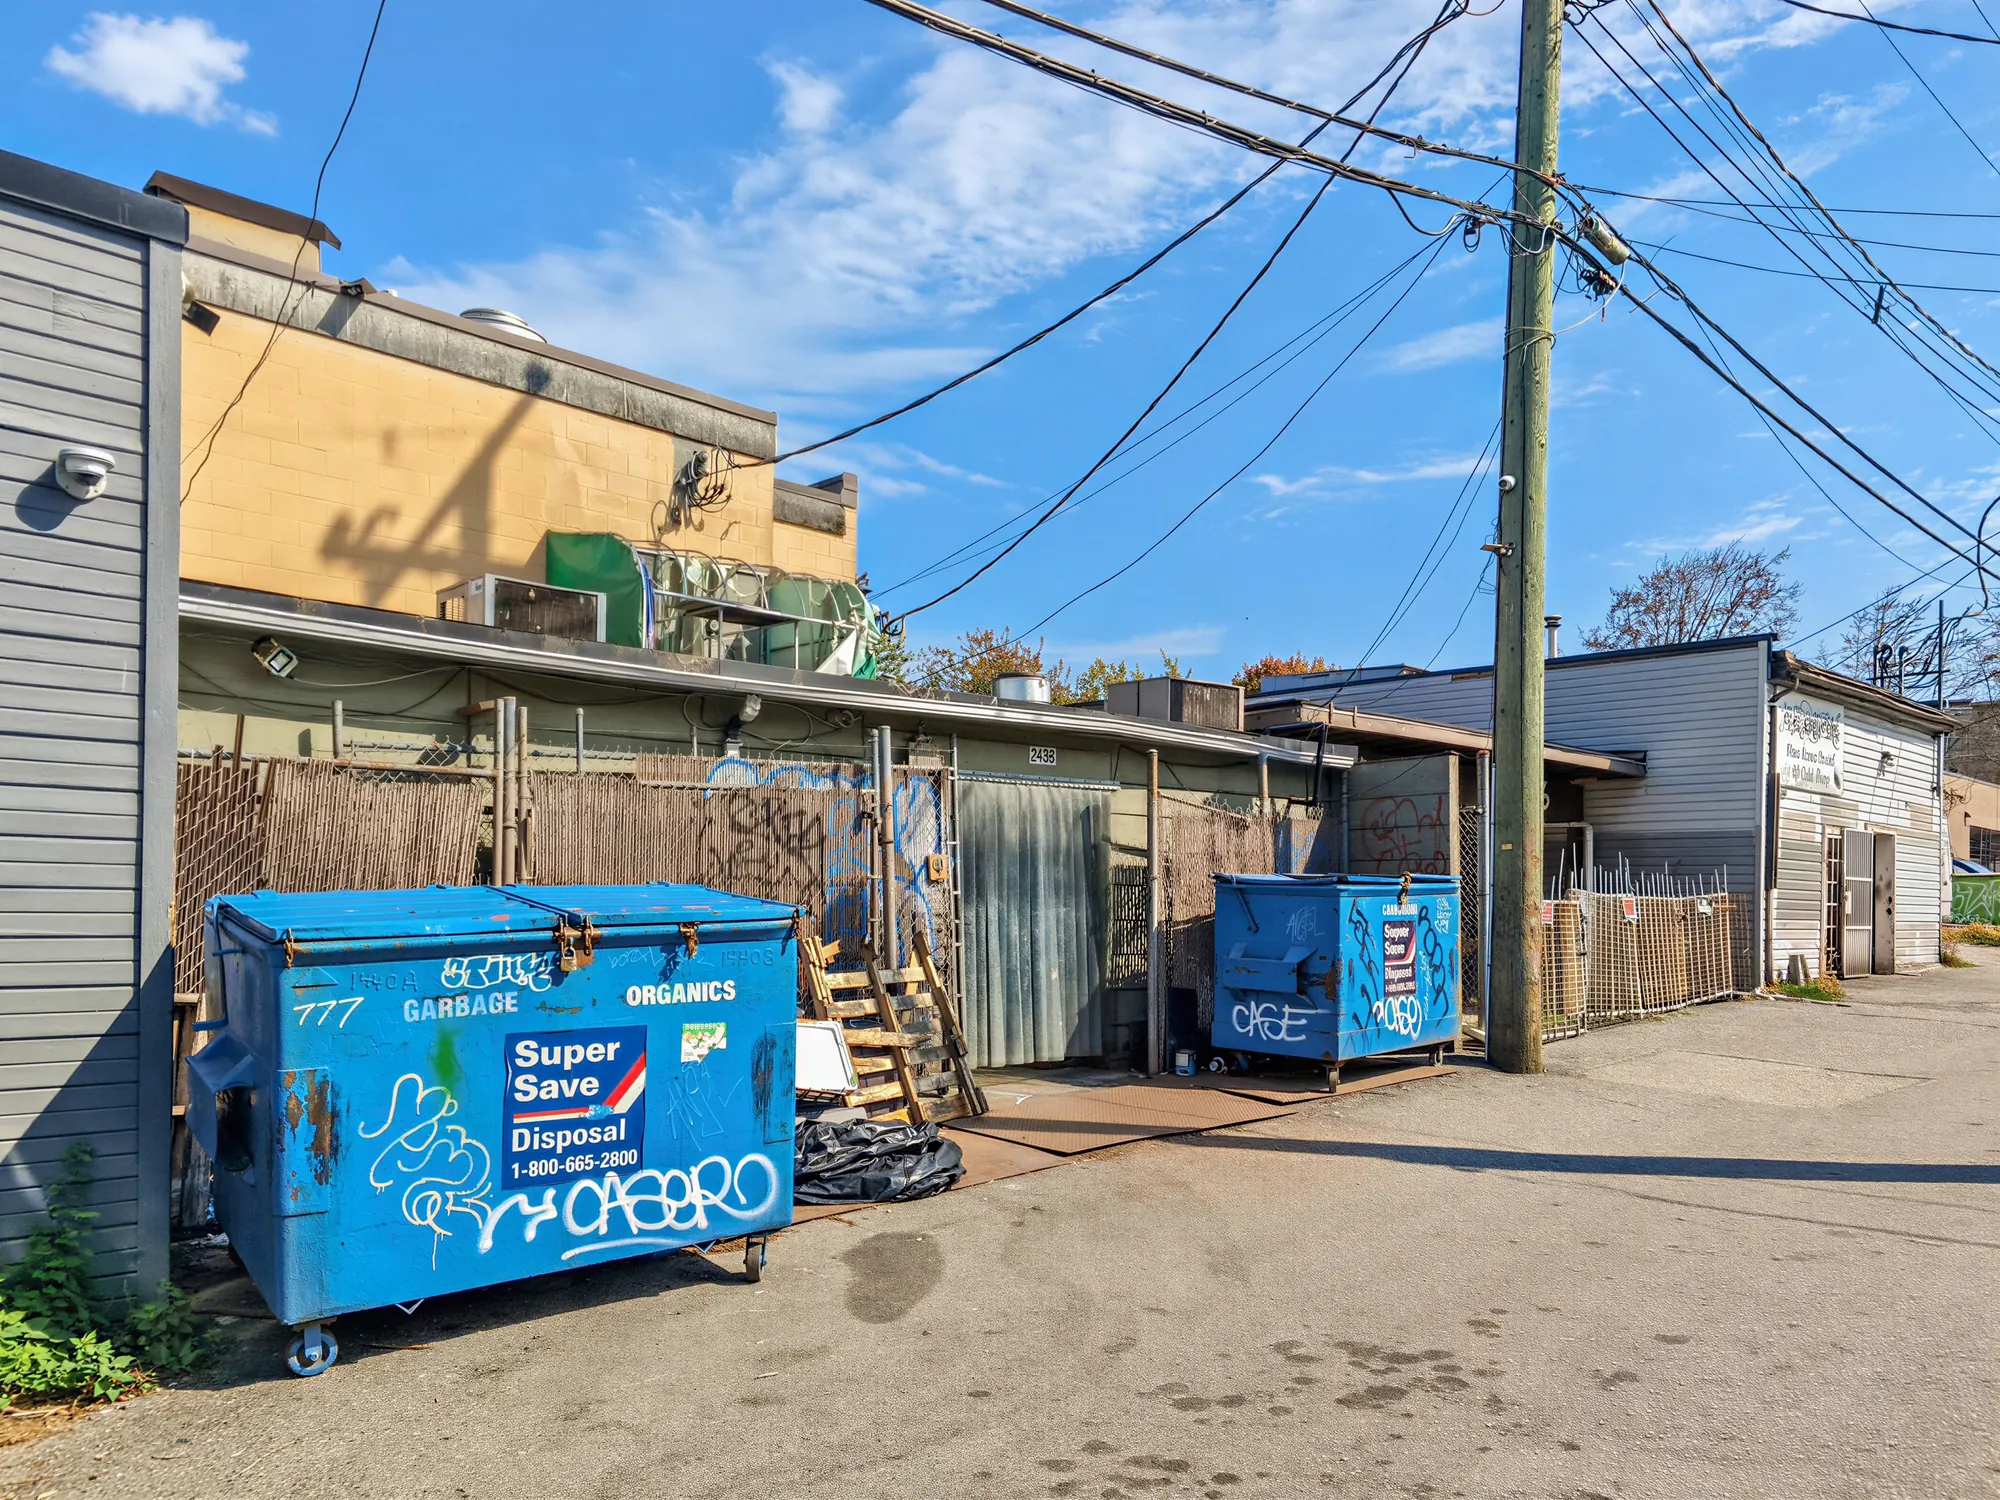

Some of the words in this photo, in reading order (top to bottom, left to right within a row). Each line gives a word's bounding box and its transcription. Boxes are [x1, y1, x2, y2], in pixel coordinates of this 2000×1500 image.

[1030, 748, 1055, 764] 2433
[403, 991, 519, 1023] GARBAGE
[626, 980, 736, 1007] ORGANICS
[514, 1040, 621, 1071] Super
[513, 1074, 600, 1102] Save
[512, 1118, 626, 1154] Disposal
[511, 1149, 638, 1180] 1-800-665-2800
